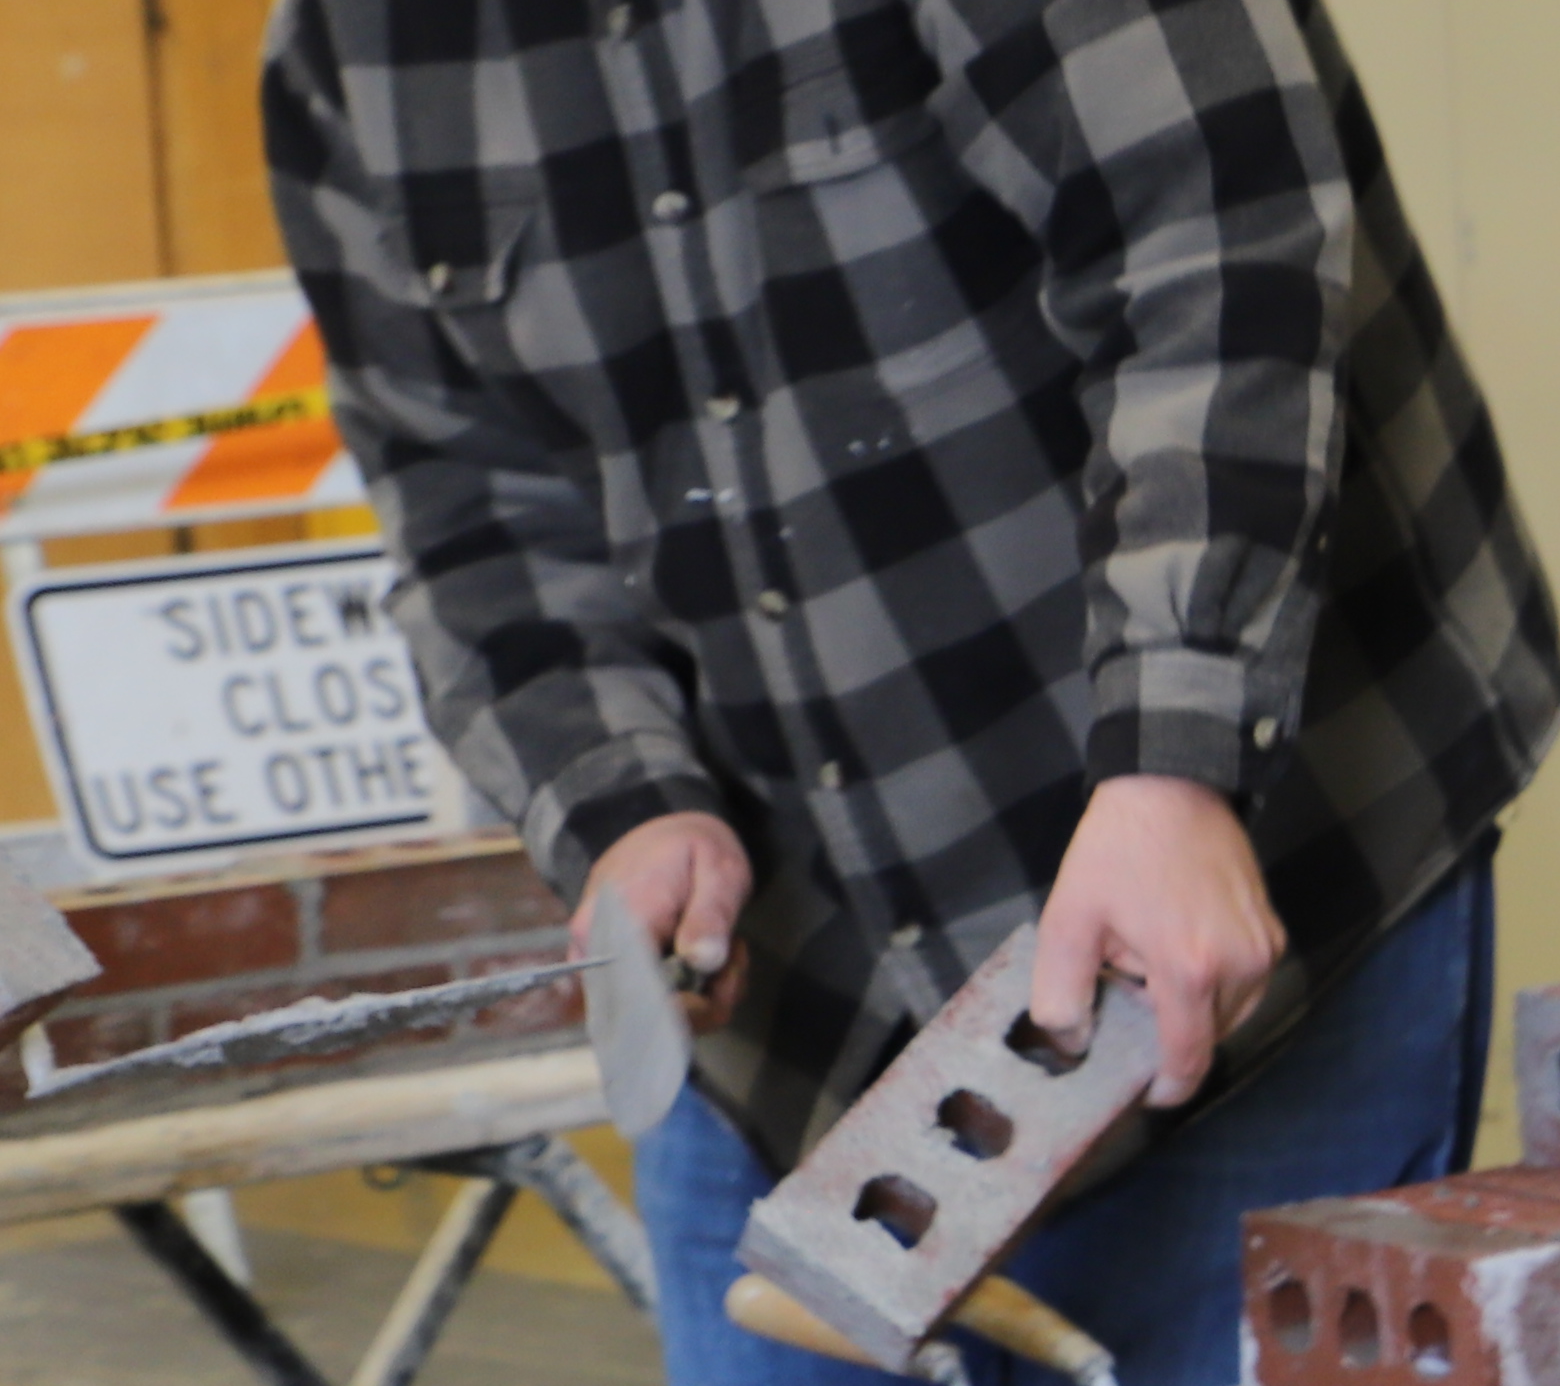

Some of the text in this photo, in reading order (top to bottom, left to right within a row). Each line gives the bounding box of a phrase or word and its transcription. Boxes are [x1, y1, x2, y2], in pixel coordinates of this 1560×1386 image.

[157, 579, 374, 661] SIDEW
[220, 657, 406, 737] CLOS
[91, 734, 431, 836] USE OTHE
